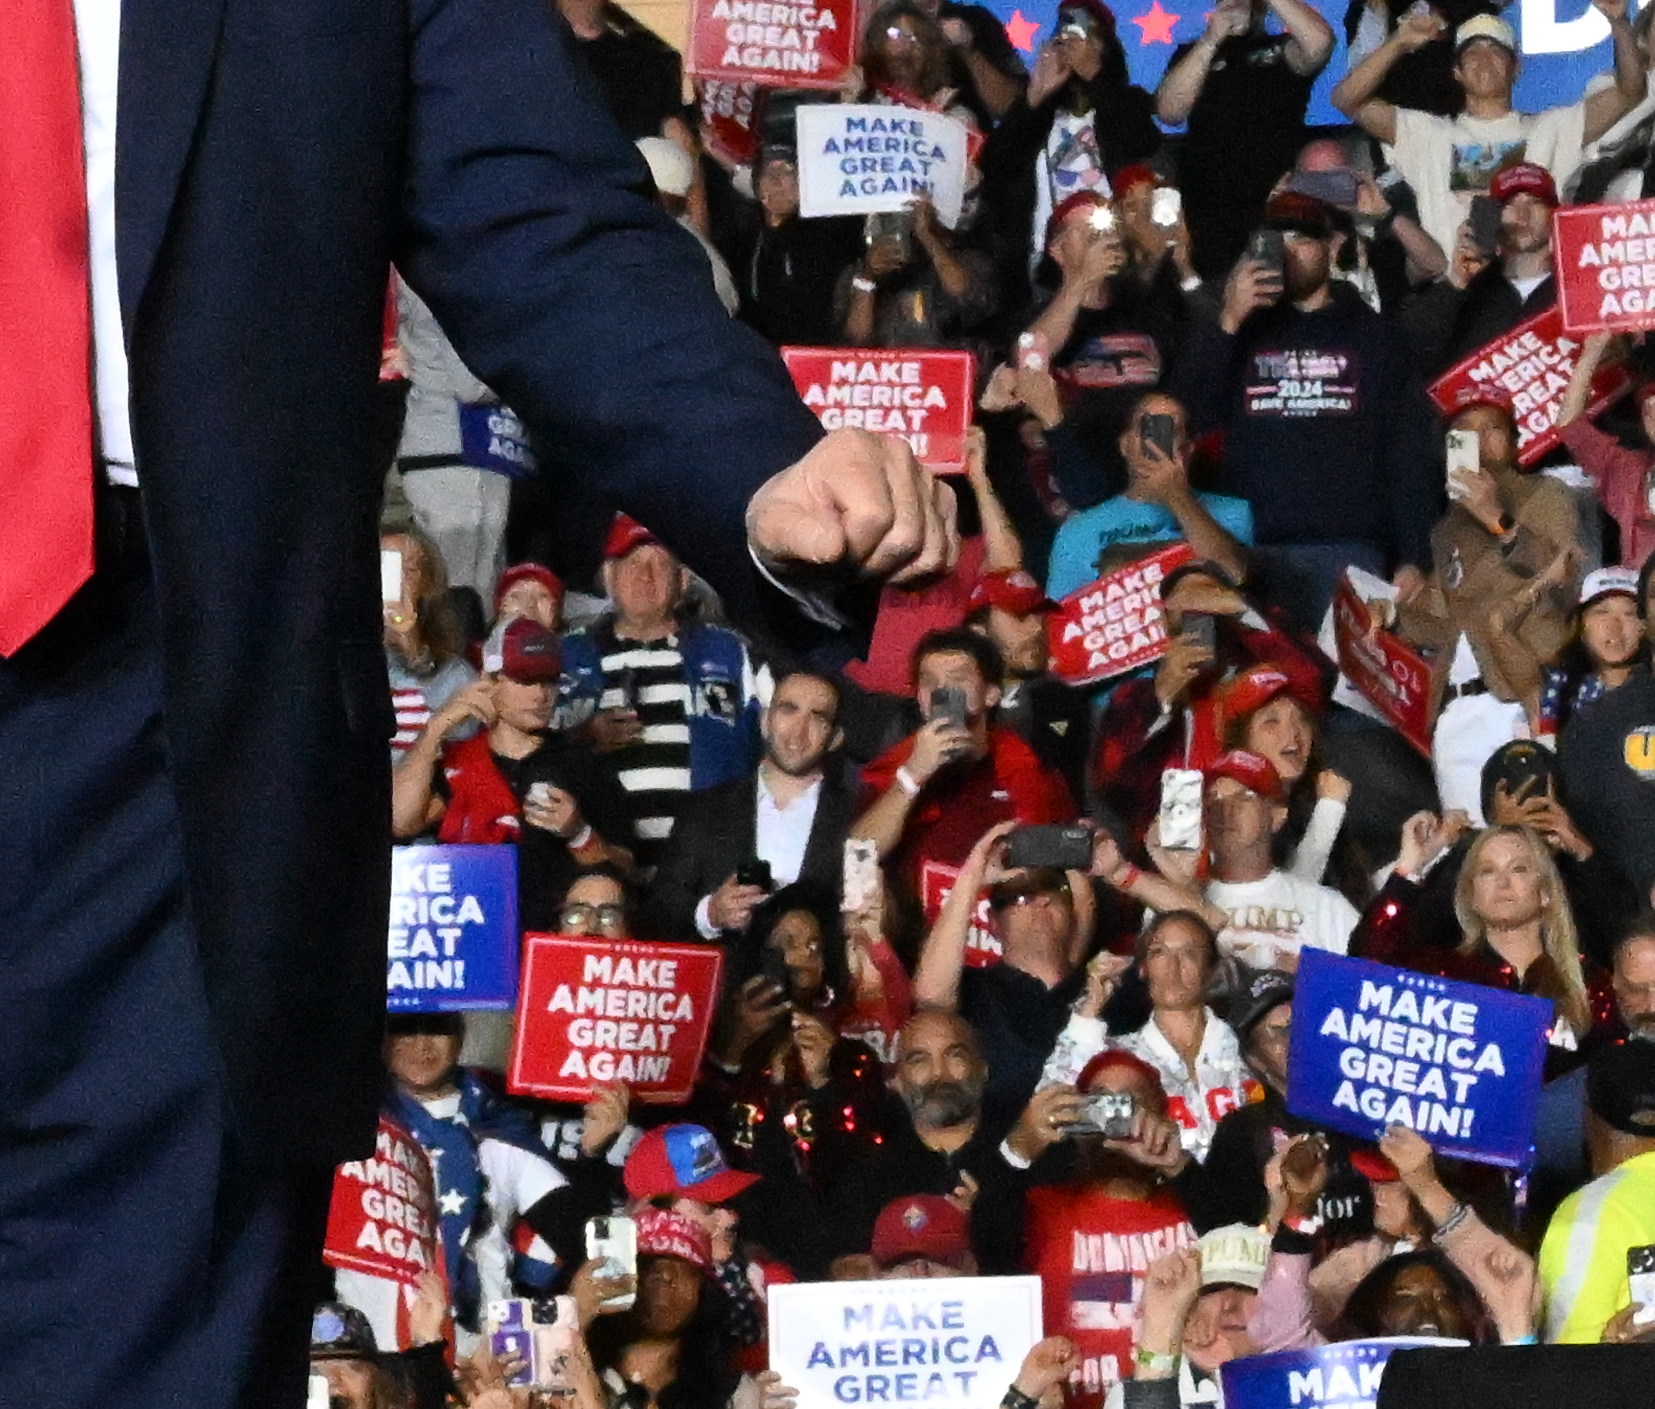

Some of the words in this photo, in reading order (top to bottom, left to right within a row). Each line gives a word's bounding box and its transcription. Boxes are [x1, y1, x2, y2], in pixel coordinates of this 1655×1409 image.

[726, 23, 819, 51] GREAT
[722, 46, 820, 73] AGAIN!
[845, 117, 924, 137] MAKE
[822, 138, 946, 162] AMERICA
[840, 158, 933, 177] GREAT
[1468, 330, 1542, 382] MAKE
[830, 361, 921, 384] MAKE
[803, 383, 947, 408] AMERICA
[821, 407, 929, 431] GREAT
[1079, 563, 1164, 613] MAKE
[584, 954, 677, 988] MAKE
[547, 983, 692, 1020] AMERICA
[1360, 980, 1478, 1035] MAKE
[568, 1018, 676, 1050] GREAT
[1320, 1007, 1506, 1077] AMERICA
[560, 1050, 671, 1082] AGAIN!
[1340, 1047, 1477, 1103] GREAT
[1332, 1080, 1475, 1137] AGAIN!
[843, 1301, 965, 1332] MAKE
[807, 1335, 1002, 1369] AMERICA
[833, 1372, 978, 1404] GREAT
